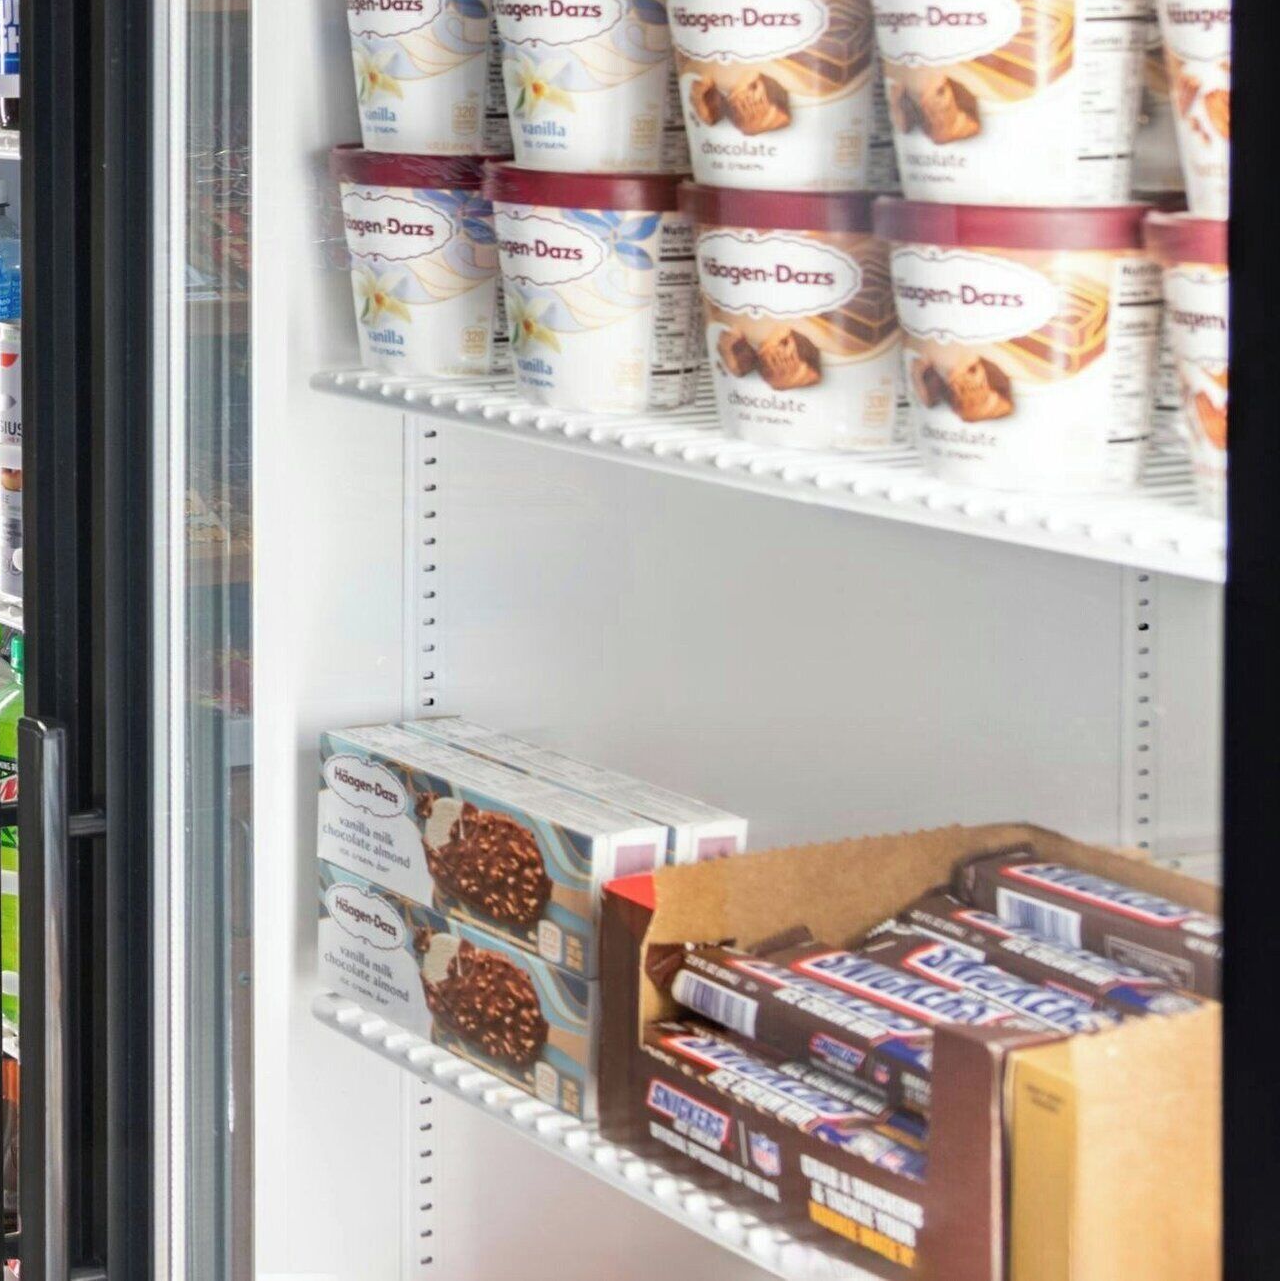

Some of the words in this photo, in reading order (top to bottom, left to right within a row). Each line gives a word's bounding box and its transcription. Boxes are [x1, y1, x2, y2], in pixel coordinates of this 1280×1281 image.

[521, 122, 566, 138] vanilla
[701, 142, 778, 157] chocolate
[727, 394, 807, 413] chocolate
[322, 824, 370, 851] chocolate
[372, 842, 412, 869] almond
[340, 817, 372, 840] vanilla
[373, 828, 395, 848] milk
[324, 951, 371, 981] chocolate
[372, 973, 410, 1002] almond
[340, 947, 371, 970] vanilla
[372, 959, 394, 979] milk
